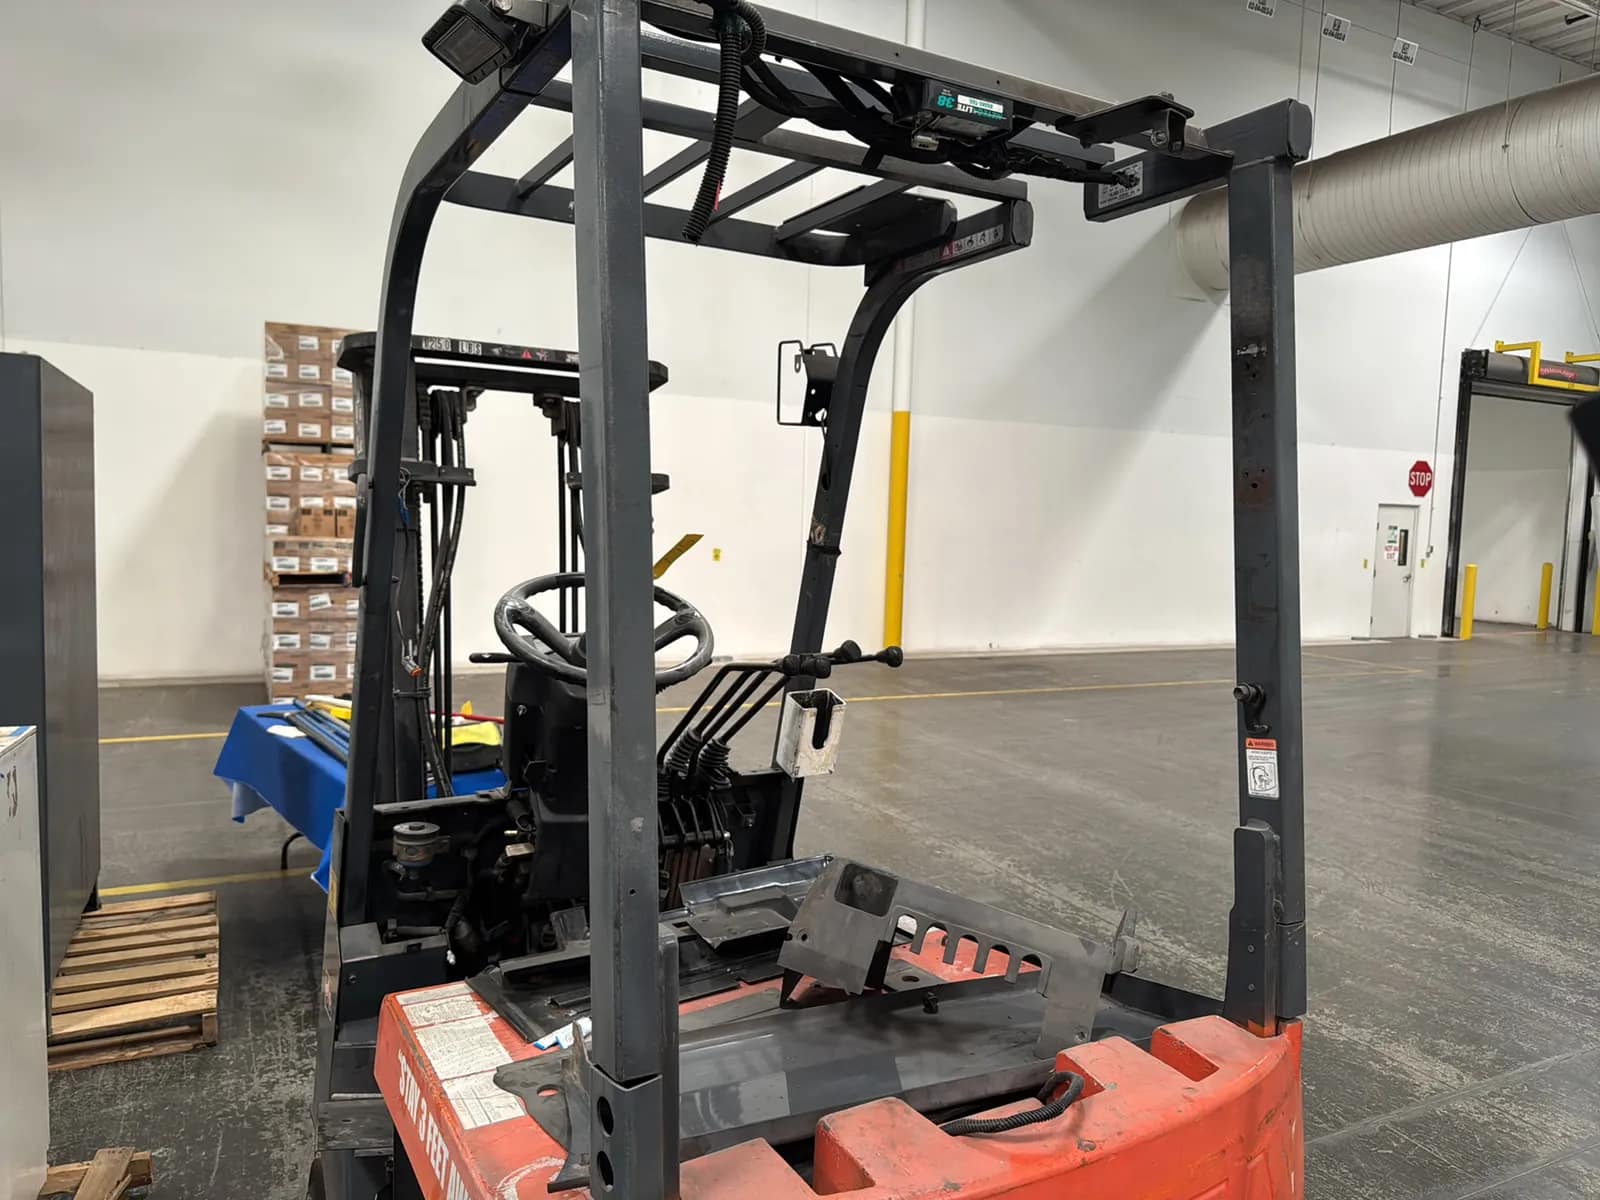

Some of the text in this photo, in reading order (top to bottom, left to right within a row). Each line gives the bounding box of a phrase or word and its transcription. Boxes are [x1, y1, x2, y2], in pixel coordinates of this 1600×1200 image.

[937, 95, 955, 109] 38
[1410, 472, 1431, 486] STOP
[419, 1097, 427, 1142] 3
[426, 1111, 449, 1190] FEET
